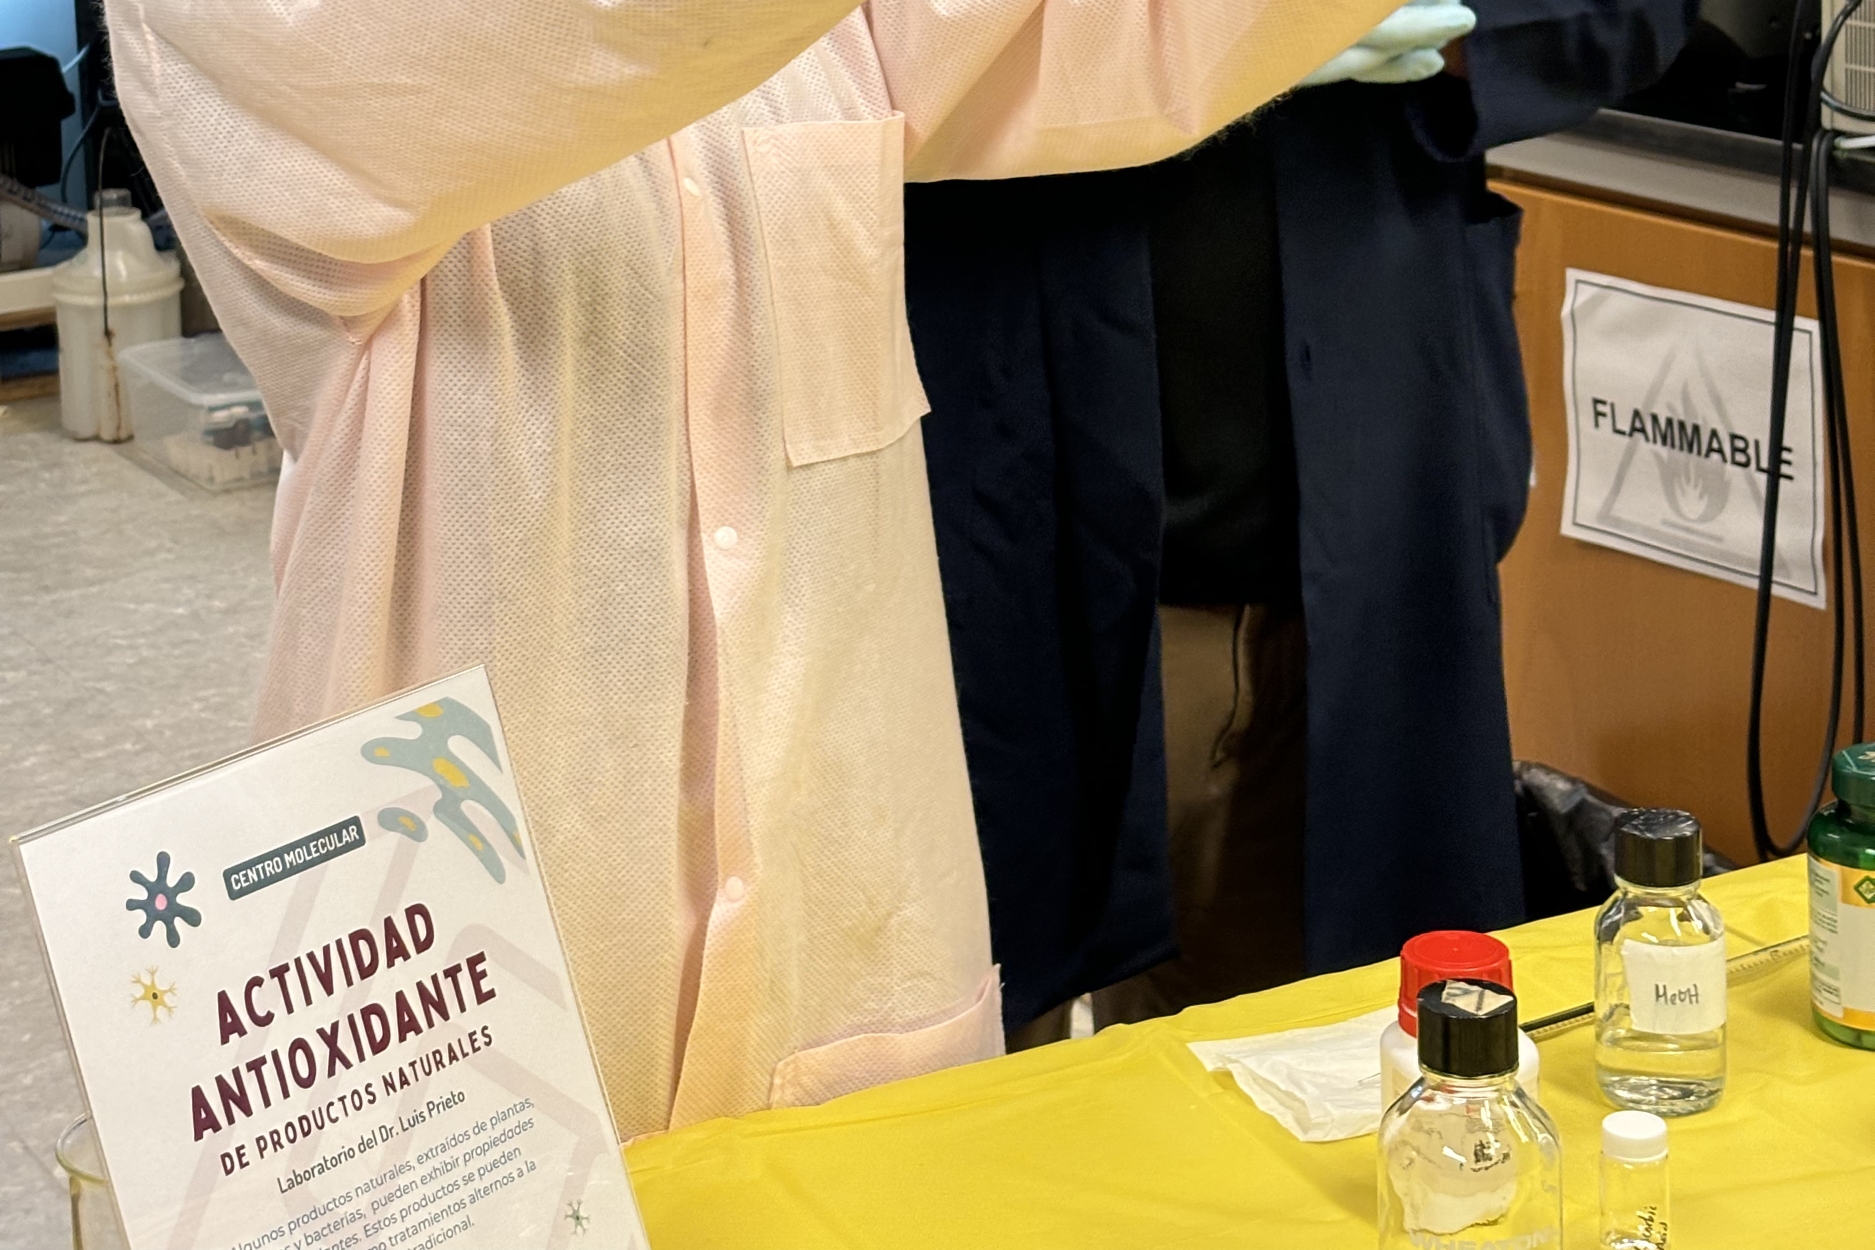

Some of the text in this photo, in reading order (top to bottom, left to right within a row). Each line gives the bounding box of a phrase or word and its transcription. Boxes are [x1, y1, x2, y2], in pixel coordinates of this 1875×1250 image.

[1592, 397, 1794, 481] FLAMMABLE
[230, 825, 360, 891] CENTRO MOLECULAR
[217, 903, 435, 1046] ACTIVIDAD
[1654, 983, 1699, 1005] MeOH
[191, 951, 497, 1142] ANTIOXIDANTE
[220, 1025, 493, 1176] DE PRODUCTOS NATURALES
[277, 1090, 466, 1194] Laboratorio del Dr. Luis Prieto
[231, 1097, 535, 1250] lgunos productos naturales, extraídos de plantas,
[304, 1208, 367, 1246] bacterías,
[370, 1179, 419, 1215] pueden
[420, 1155, 460, 1186] exhibir
[463, 1117, 535, 1167] propiedades
[363, 1213, 398, 1238] Estos
[399, 1178, 461, 1223] productos
[461, 1171, 476, 1186] se
[477, 1146, 523, 1181] pueden
[388, 1159, 537, 1247] tratamientos alternos a la
[407, 1215, 475, 1250] adicional.
